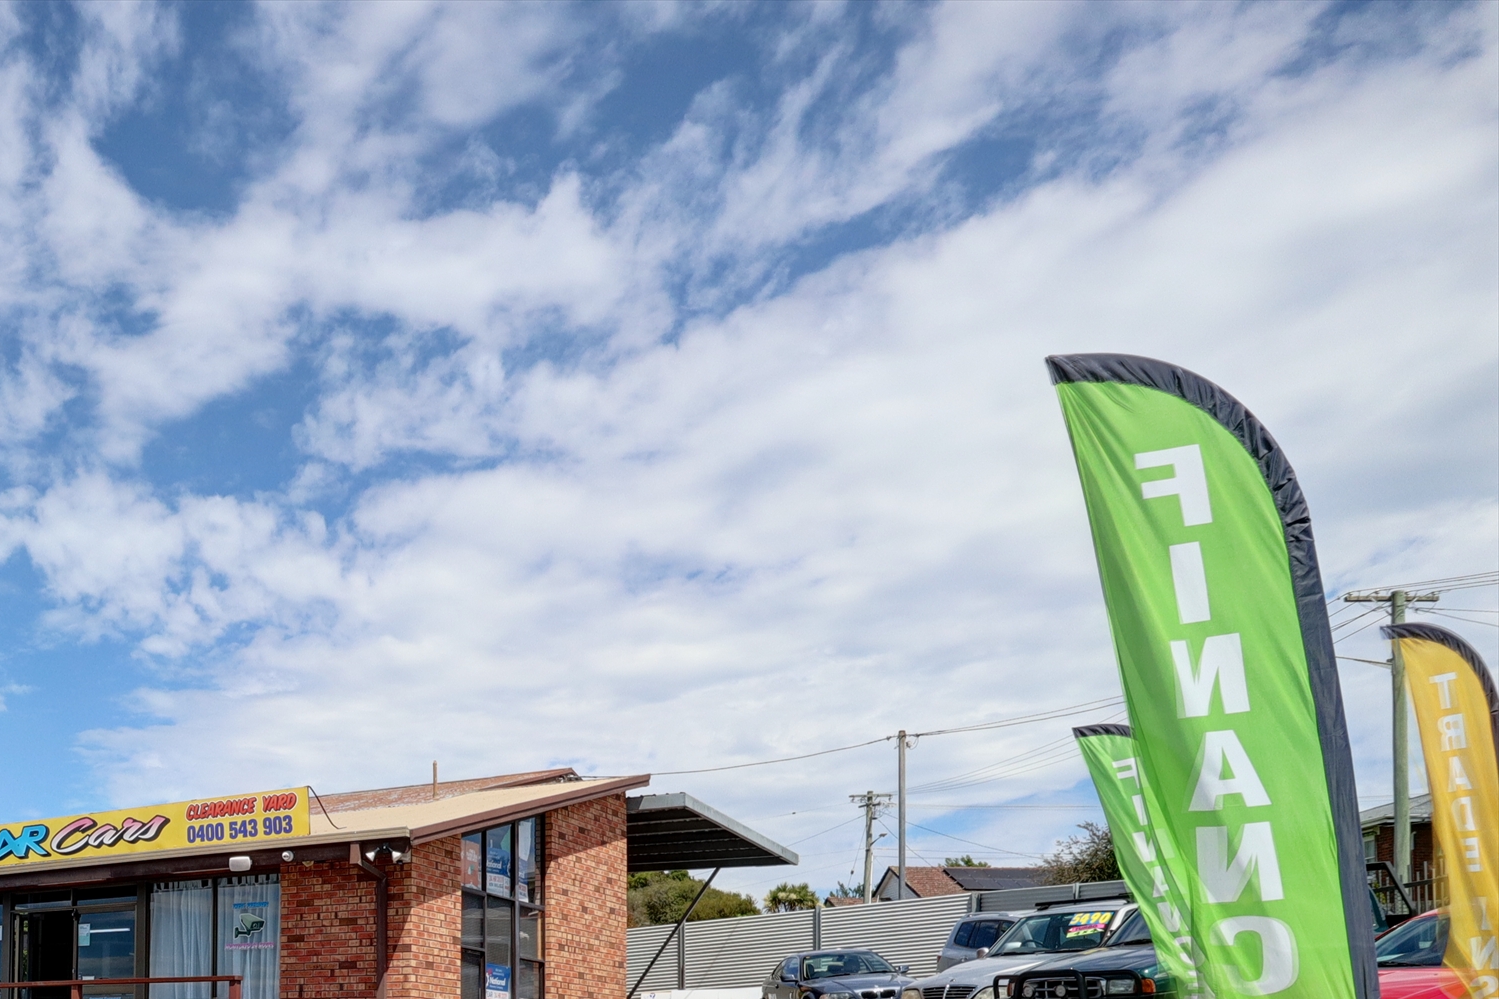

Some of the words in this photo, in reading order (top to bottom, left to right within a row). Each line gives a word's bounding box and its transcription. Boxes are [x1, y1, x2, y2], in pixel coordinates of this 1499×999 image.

[186, 796, 258, 821] CLEARANCE
[262, 792, 298, 813] YARD
[51, 815, 170, 854] Cars
[187, 822, 224, 844] 0400
[229, 818, 258, 840] 543
[263, 814, 293, 836] 903
[1069, 911, 1112, 925] 5490
